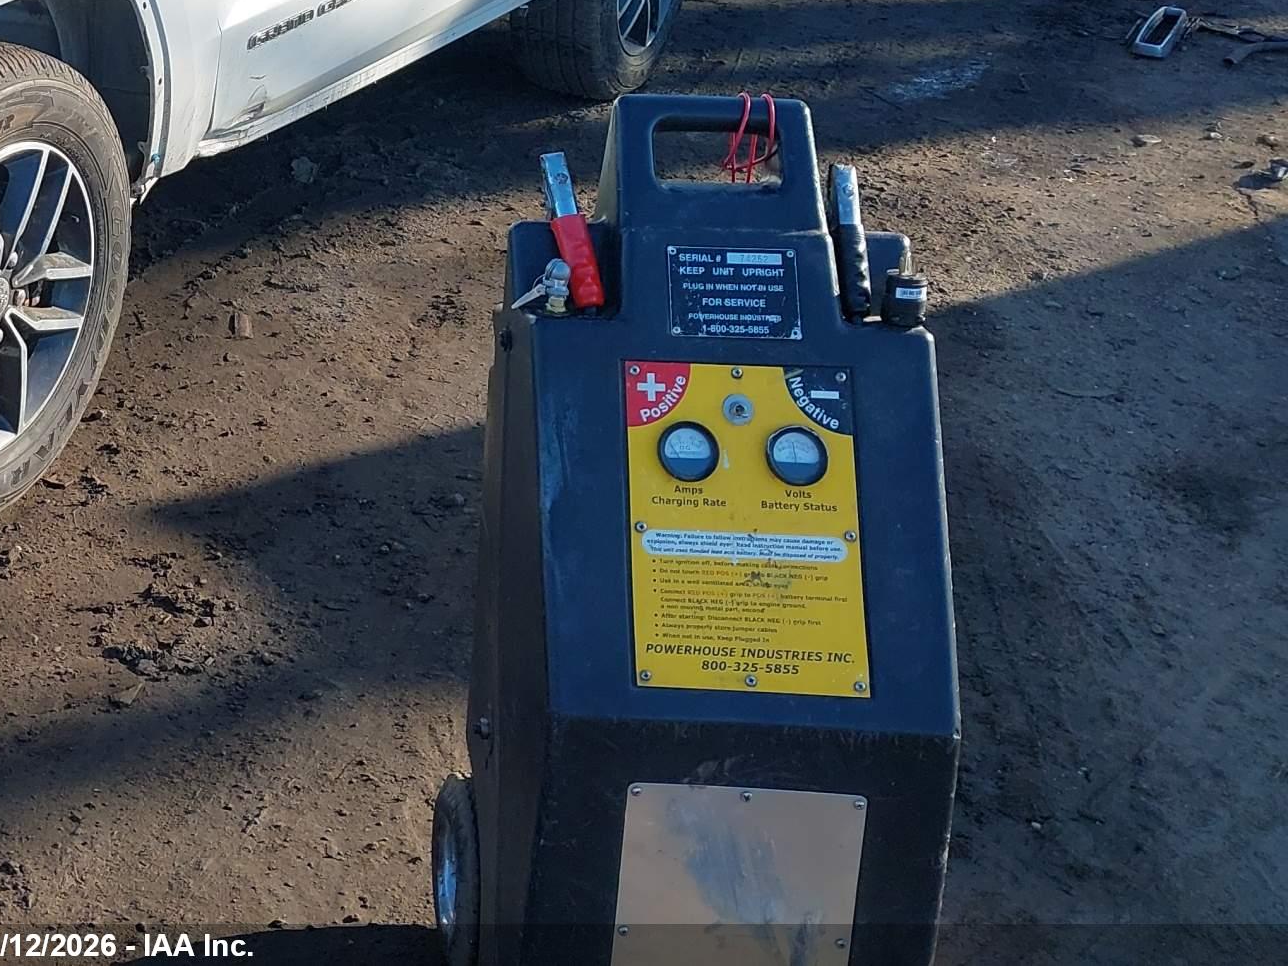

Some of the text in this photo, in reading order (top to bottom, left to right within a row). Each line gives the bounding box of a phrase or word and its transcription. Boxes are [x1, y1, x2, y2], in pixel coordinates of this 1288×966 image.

[678, 254, 714, 262] SERIAL
[679, 266, 785, 277] KEEP UNIT UPRIGHT
[682, 282, 704, 290] PLUG
[702, 298, 766, 307] FOR SERVICE
[688, 313, 738, 321] POWERHOUSE
[702, 325, 770, 334] 1-800-325-5855
[640, 374, 686, 422] Positive
[788, 376, 840, 430] Negative
[674, 485, 703, 495] Amps
[785, 490, 812, 499] Volts
[652, 496, 726, 508] Charging Rate
[761, 500, 838, 512] Battery Status
[655, 532, 683, 540] Warning:
[782, 552, 806, 560] disposed
[814, 553, 839, 561] properly.
[675, 559, 700, 567] ignition
[735, 561, 759, 569] making
[780, 593, 803, 601] battery
[680, 604, 704, 612] moving
[661, 622, 684, 630] Always
[686, 623, 712, 631] properly
[734, 635, 760, 644] Plugged
[646, 643, 855, 663] POWERHOUSE INDUSTRIES INC.
[701, 660, 800, 674] 800-325-5855
